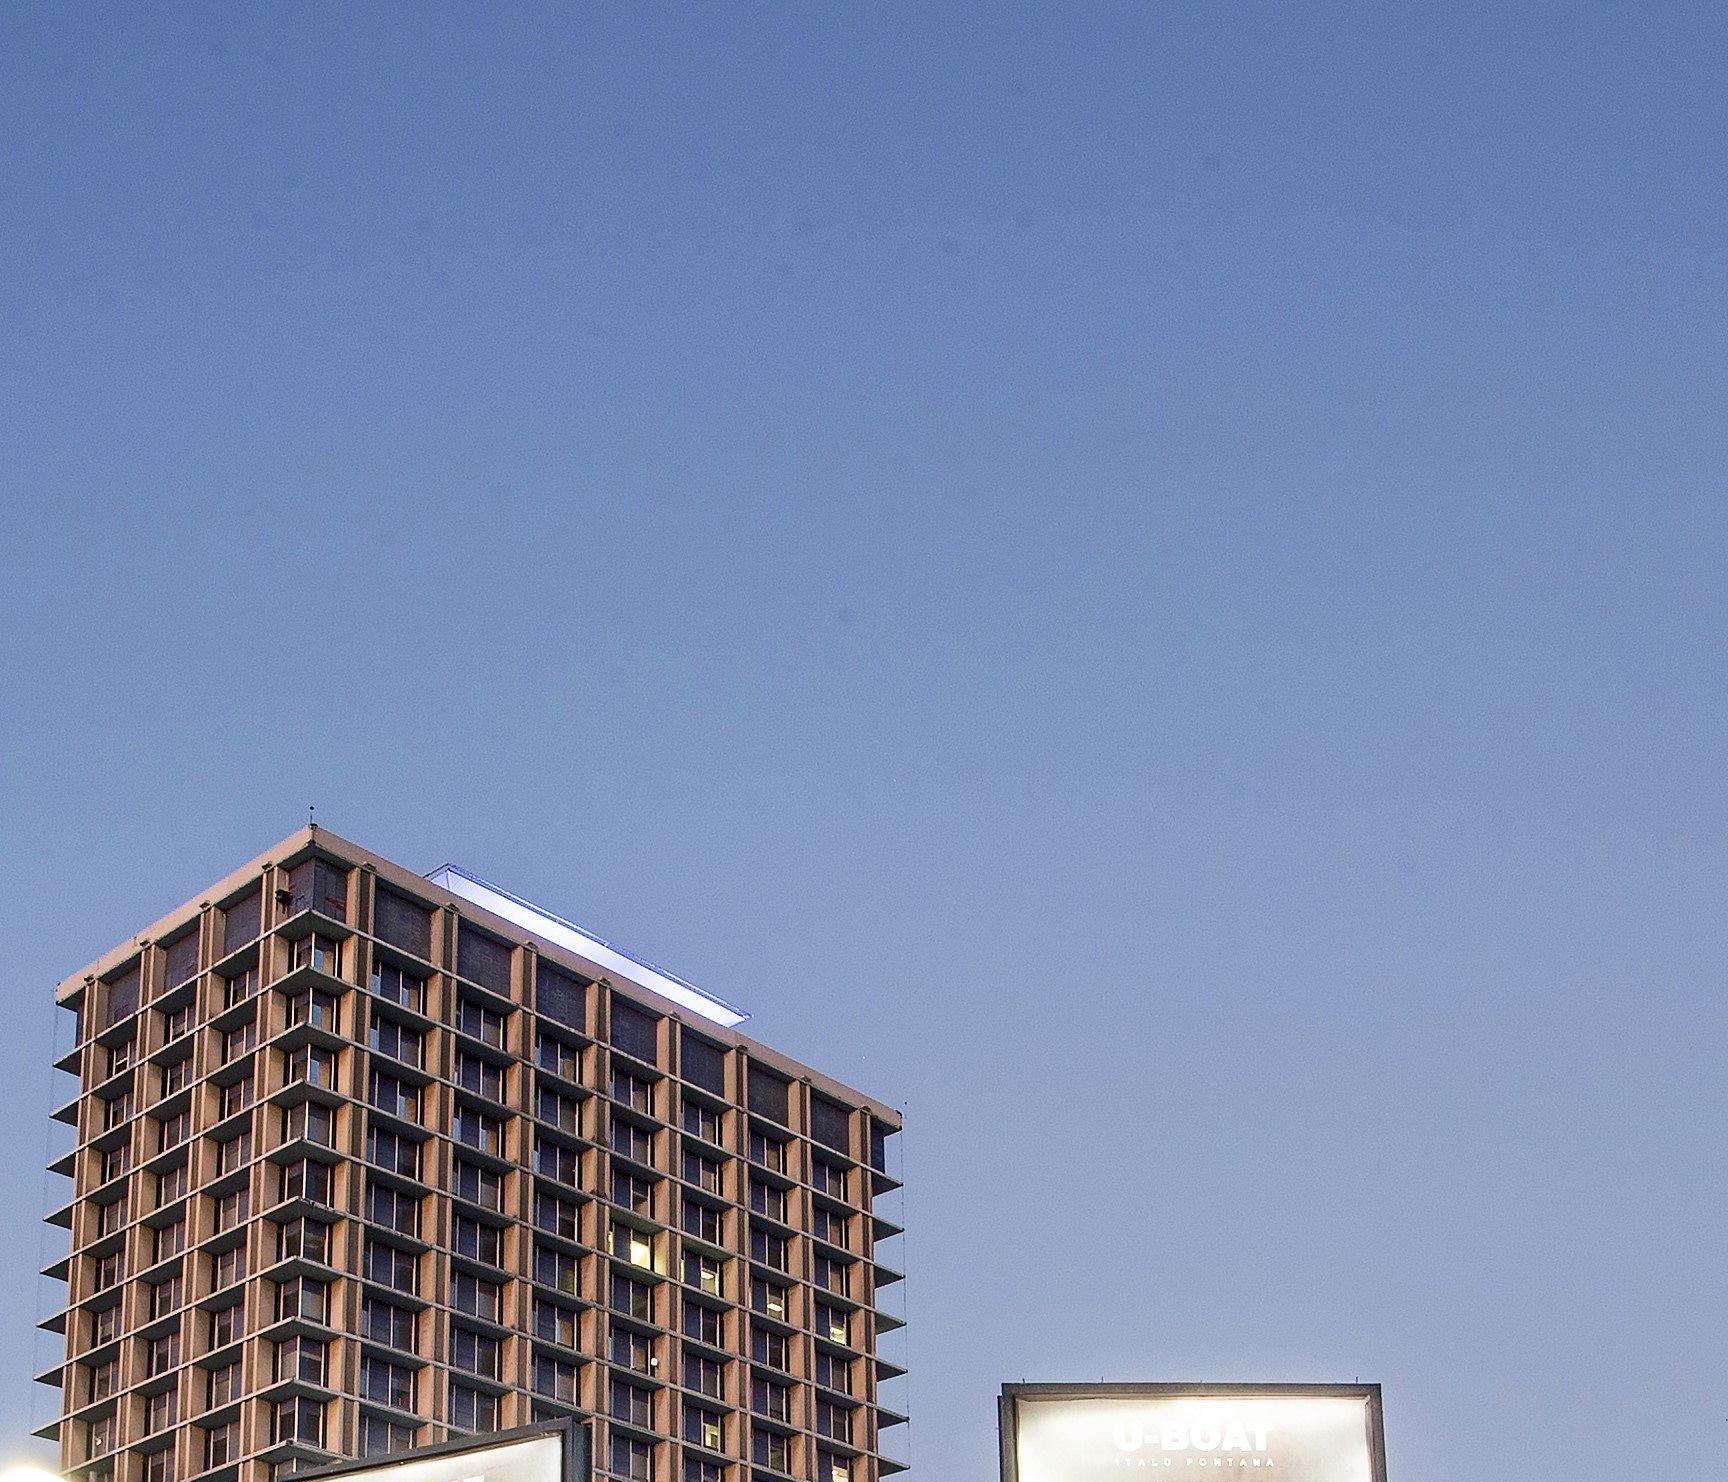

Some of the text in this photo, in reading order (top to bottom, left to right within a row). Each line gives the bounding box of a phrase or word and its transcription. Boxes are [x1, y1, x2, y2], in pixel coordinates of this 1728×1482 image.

[1112, 1418, 1275, 1452] U-BOAT
[1115, 1457, 1275, 1468] ITALO FONTANA
